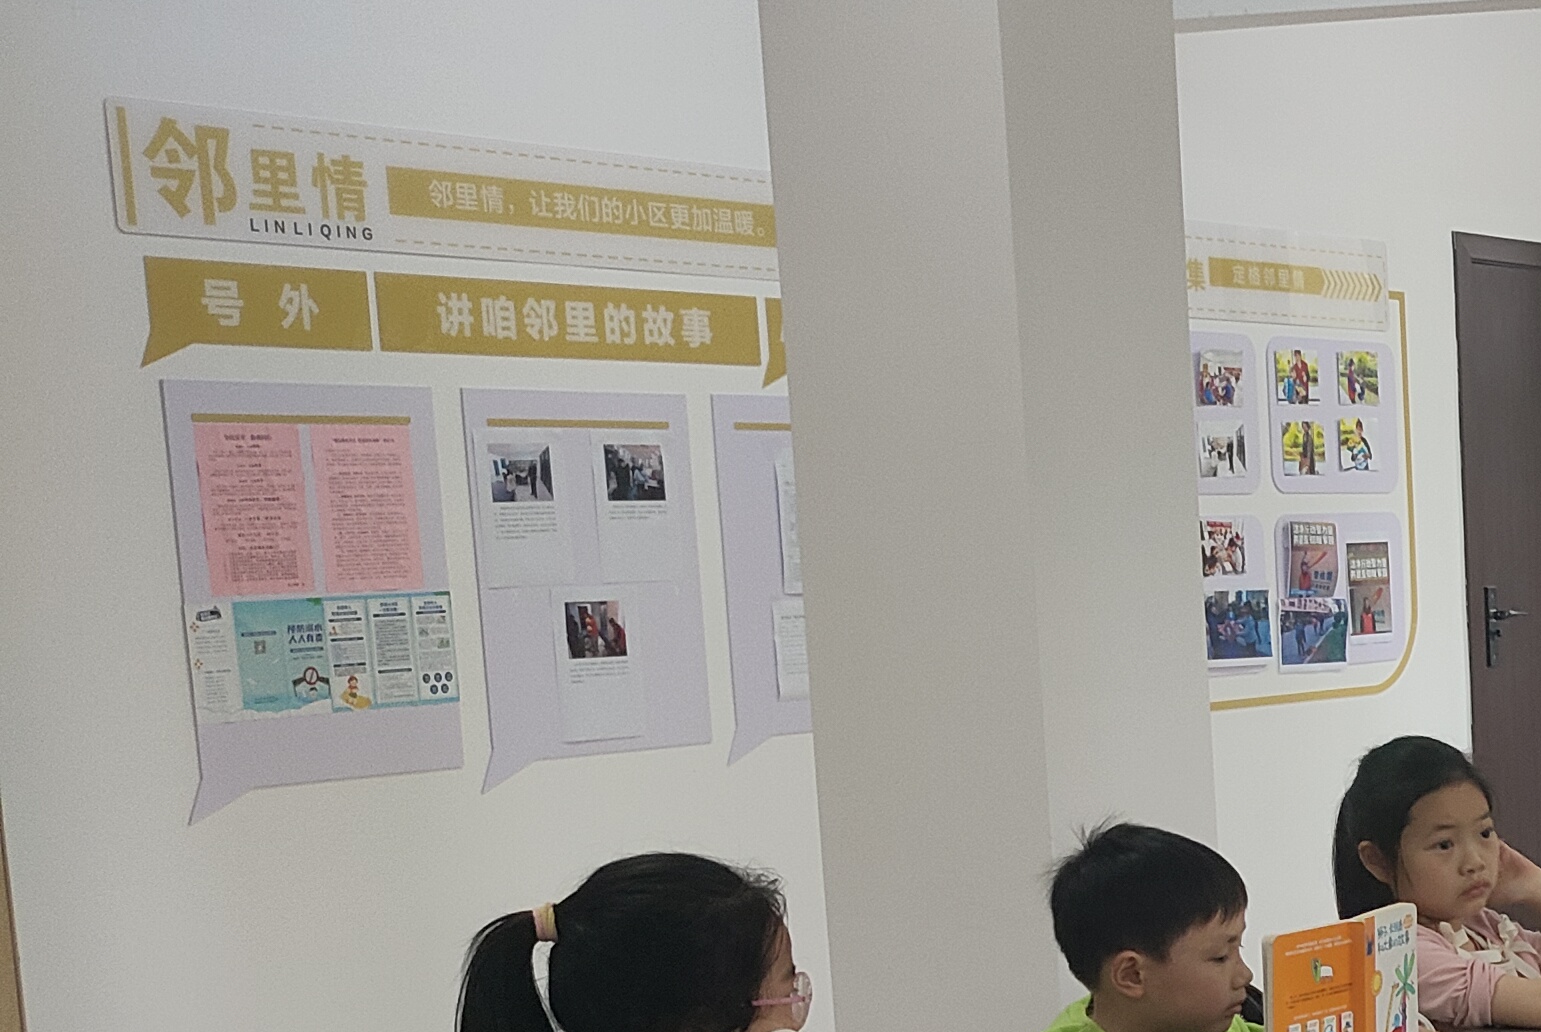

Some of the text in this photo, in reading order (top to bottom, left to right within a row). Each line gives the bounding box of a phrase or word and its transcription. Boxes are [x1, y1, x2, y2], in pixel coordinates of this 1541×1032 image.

[142, 115, 368, 226] 邻里情
[435, 291, 715, 348] 讲咱邻里的故事
